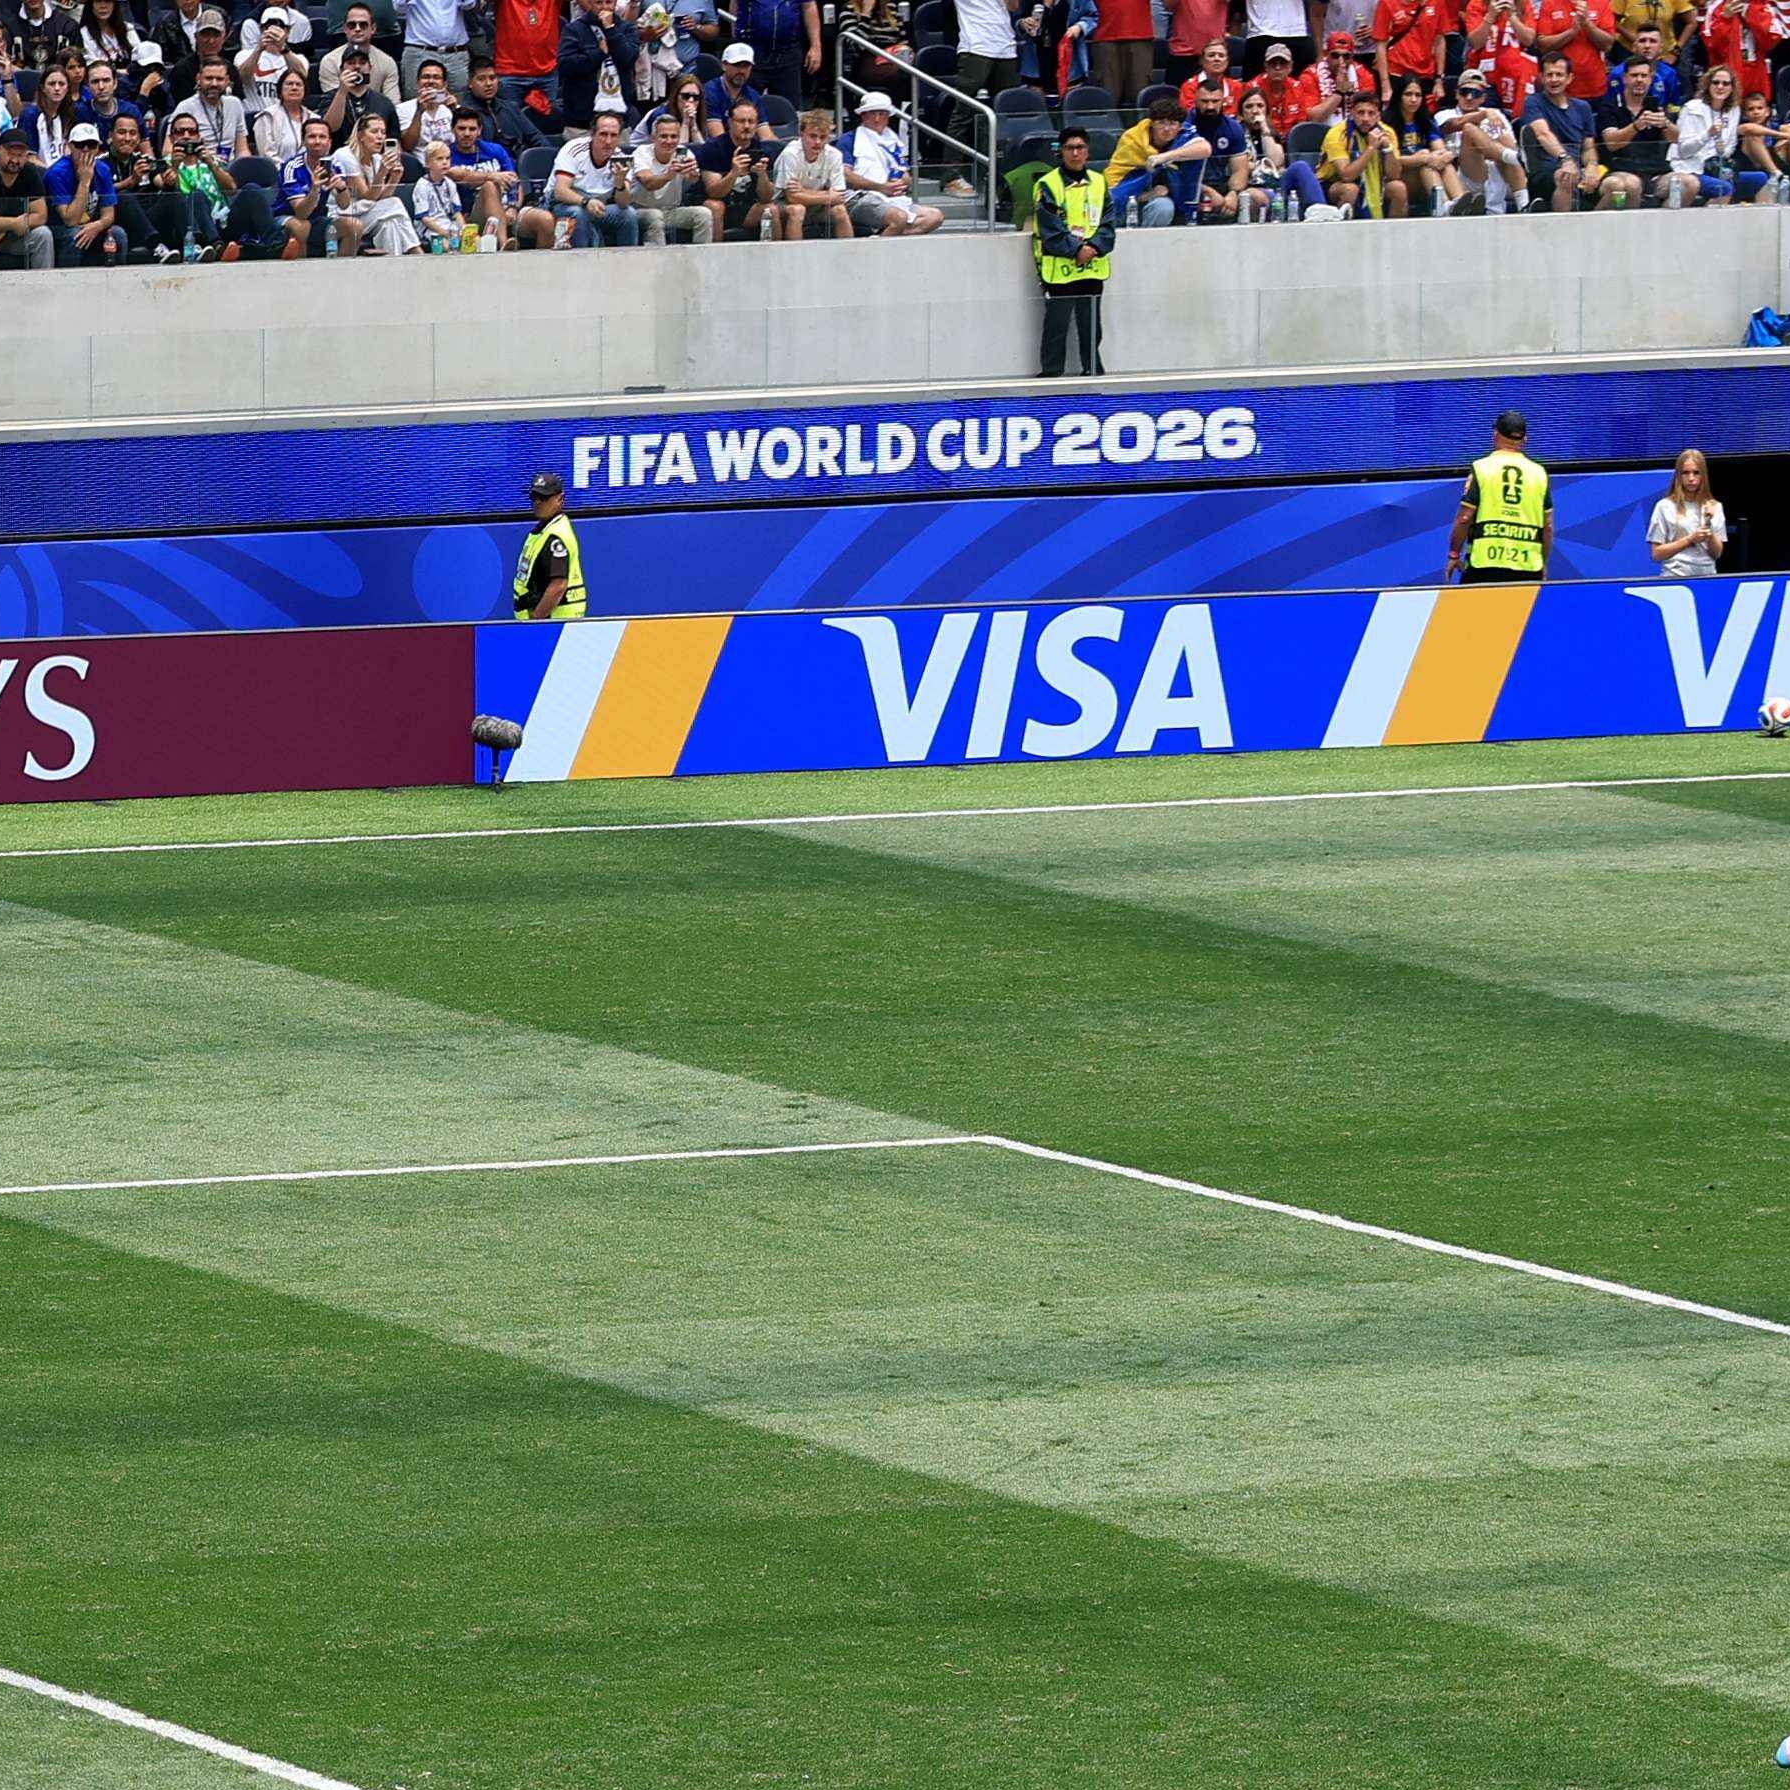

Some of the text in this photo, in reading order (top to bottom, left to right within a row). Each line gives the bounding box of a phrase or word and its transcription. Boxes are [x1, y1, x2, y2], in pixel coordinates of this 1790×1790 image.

[572, 407, 1257, 489] FIFA WORLD CUP 2026
[821, 603, 1234, 763] VISA
